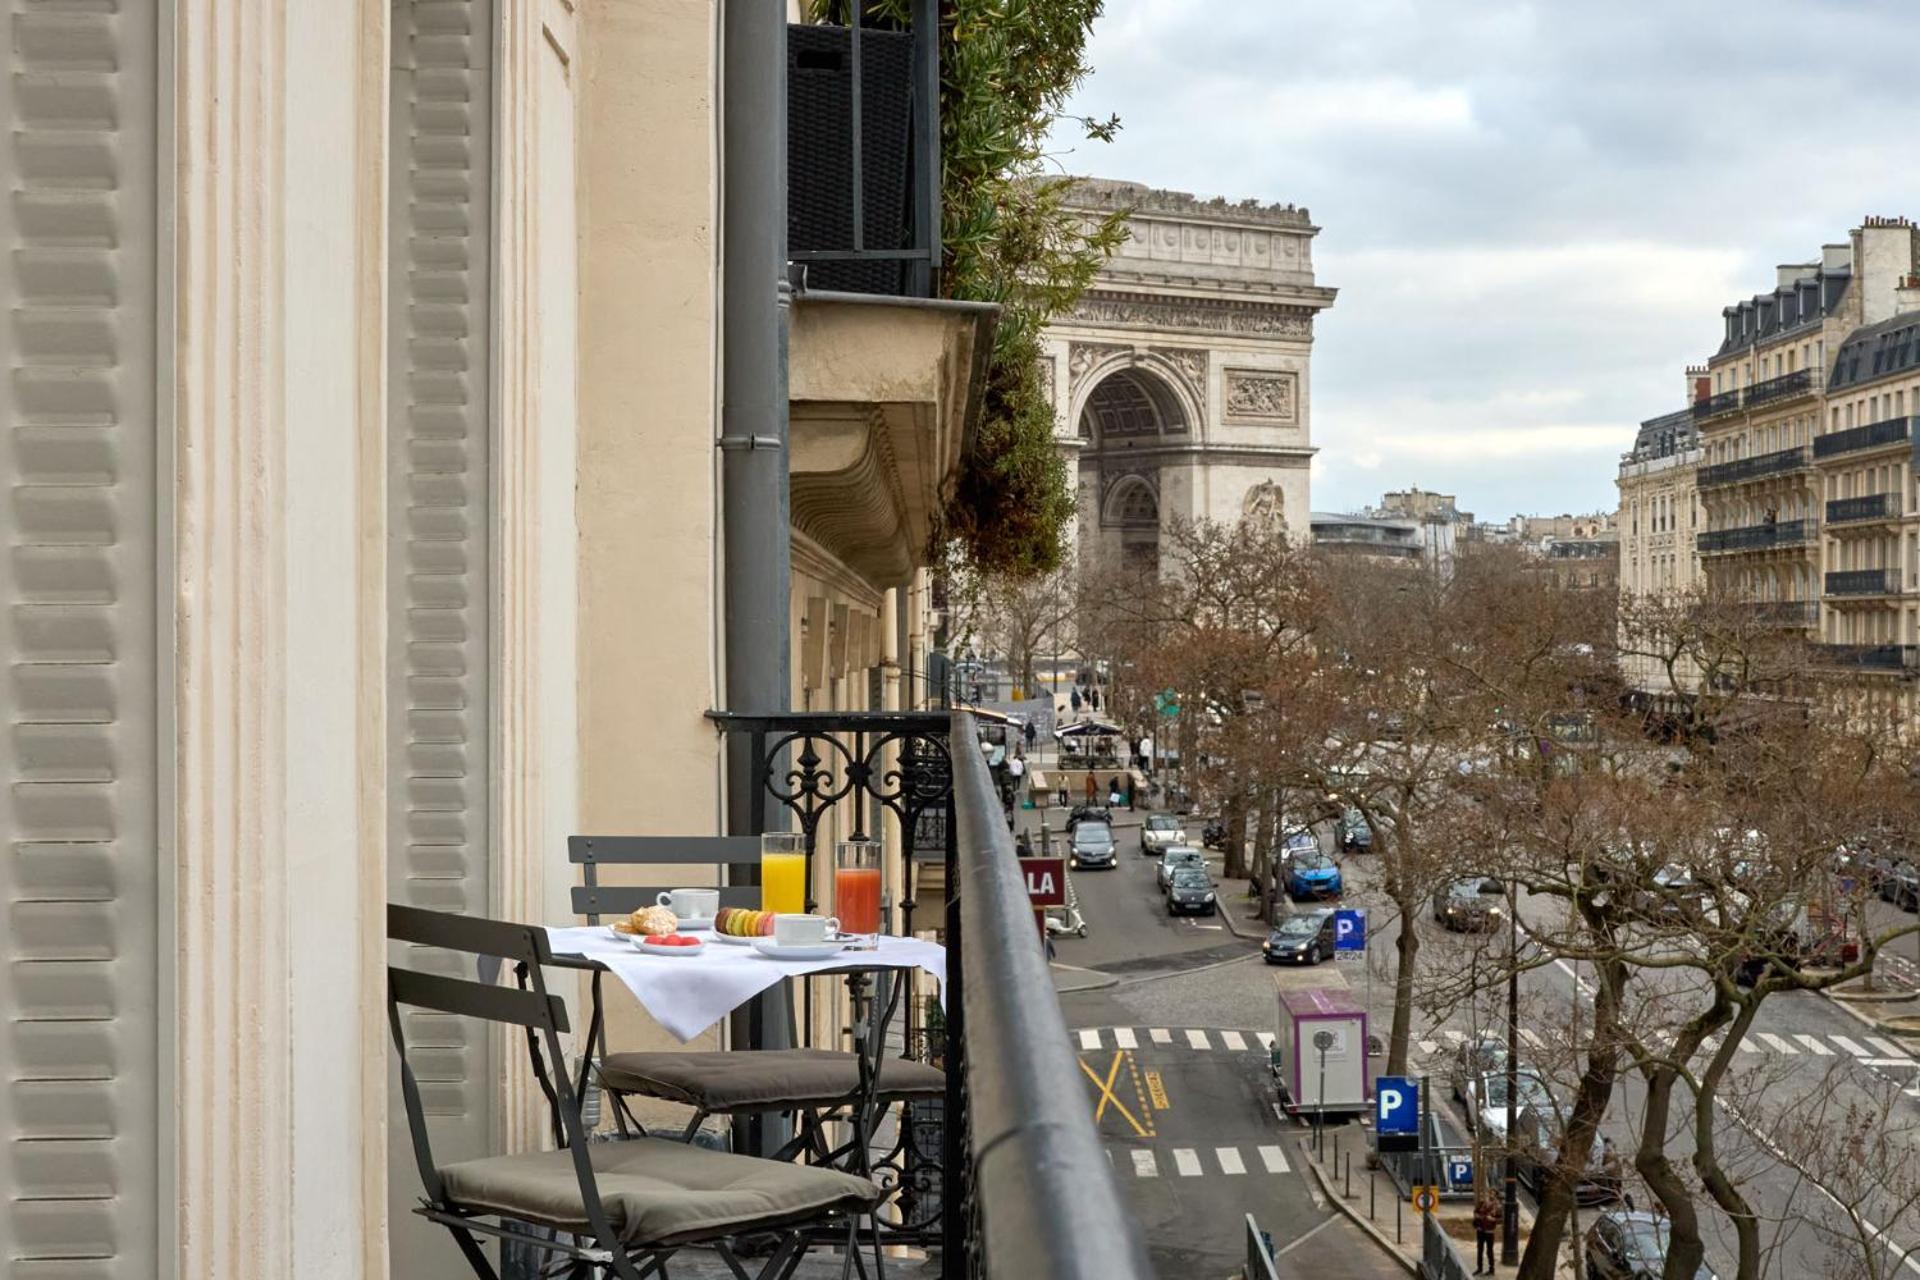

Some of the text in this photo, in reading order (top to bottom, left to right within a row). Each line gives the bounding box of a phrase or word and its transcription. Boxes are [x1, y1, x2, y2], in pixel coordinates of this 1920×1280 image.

[1028, 872, 1055, 894] LA
[1337, 919, 1353, 941] P
[1380, 1089, 1403, 1120] P
[1455, 1164, 1468, 1179] P
